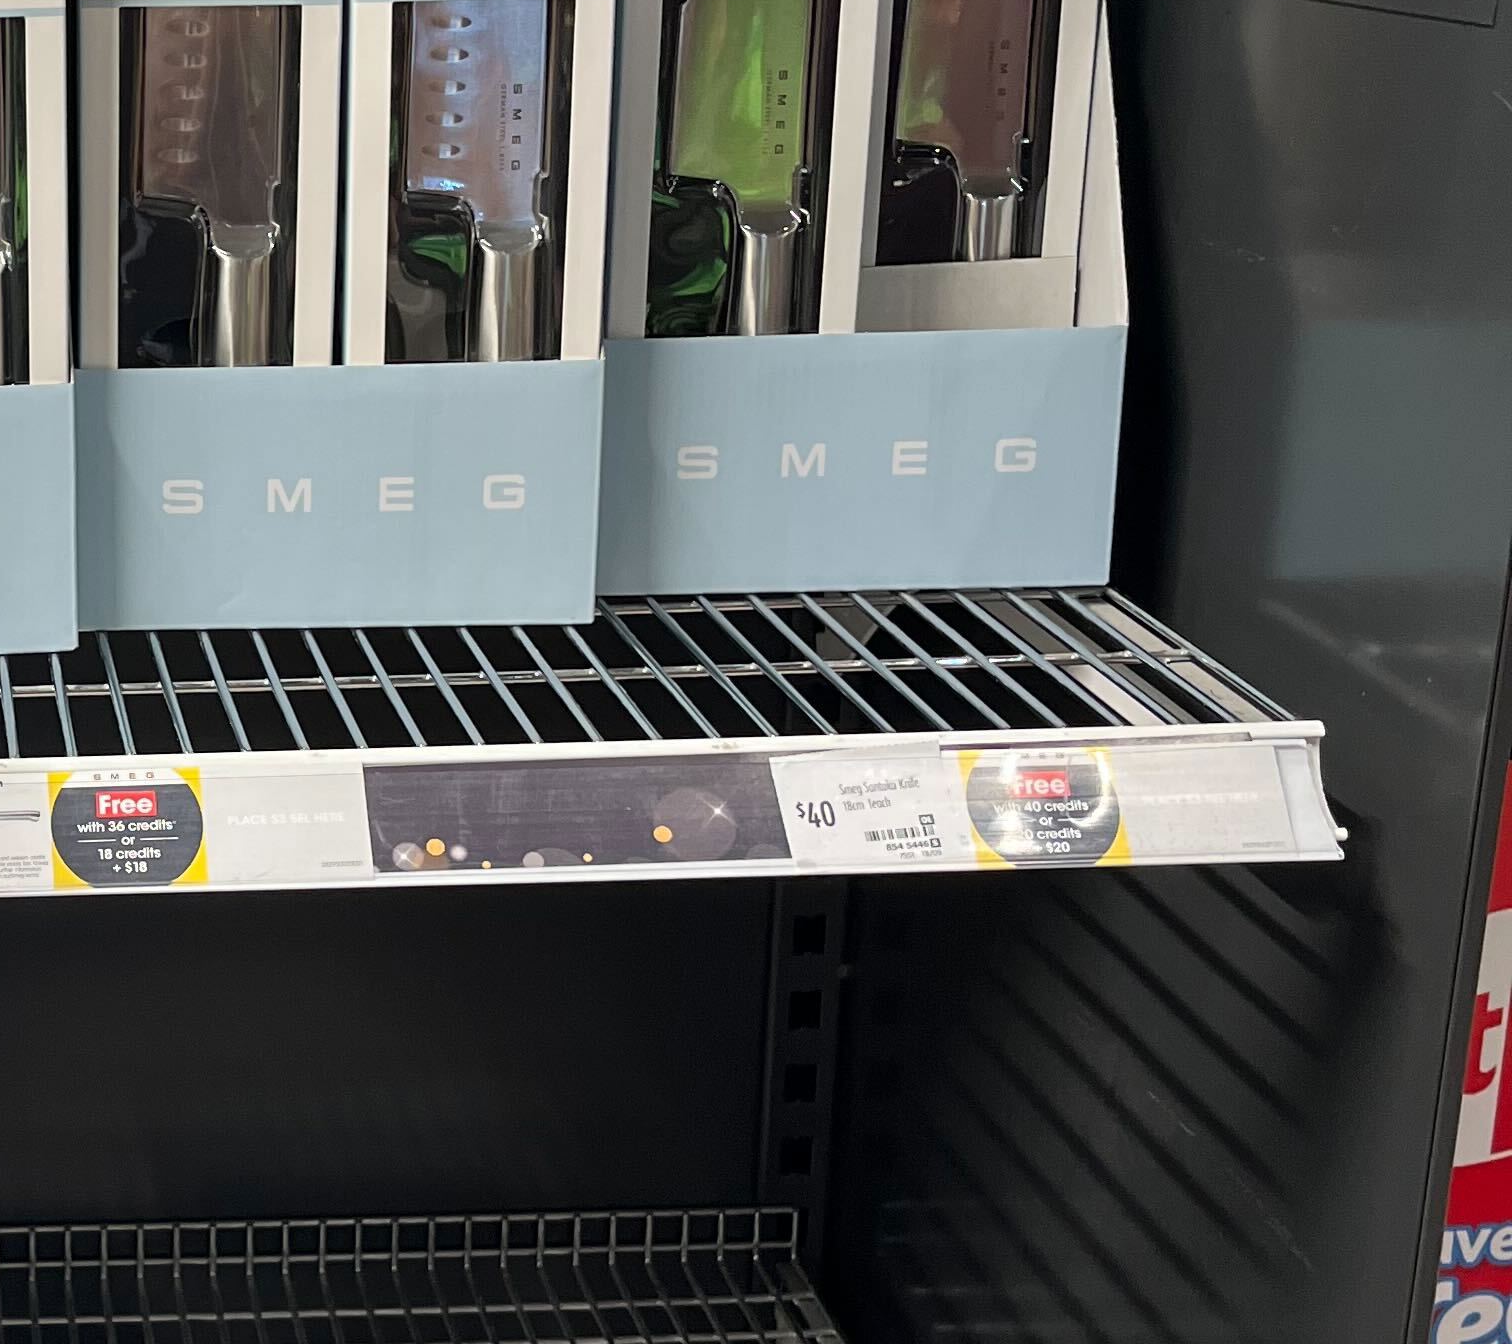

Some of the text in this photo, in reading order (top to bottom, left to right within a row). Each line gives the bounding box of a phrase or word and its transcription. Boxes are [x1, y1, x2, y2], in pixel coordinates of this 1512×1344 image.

[677, 436, 1038, 480] SMEG
[163, 473, 526, 516] SMEG
[1014, 778, 1066, 796] Free
[98, 793, 154, 816] Free
[1024, 799, 1042, 813] 40
[1044, 798, 1089, 813] credits
[796, 799, 836, 829] $40
[76, 822, 106, 834] with
[108, 821, 126, 832] 36
[1037, 827, 1082, 840] credits
[98, 847, 162, 860] 18 credits
[1045, 841, 1071, 855] $20
[124, 861, 148, 874] $18
